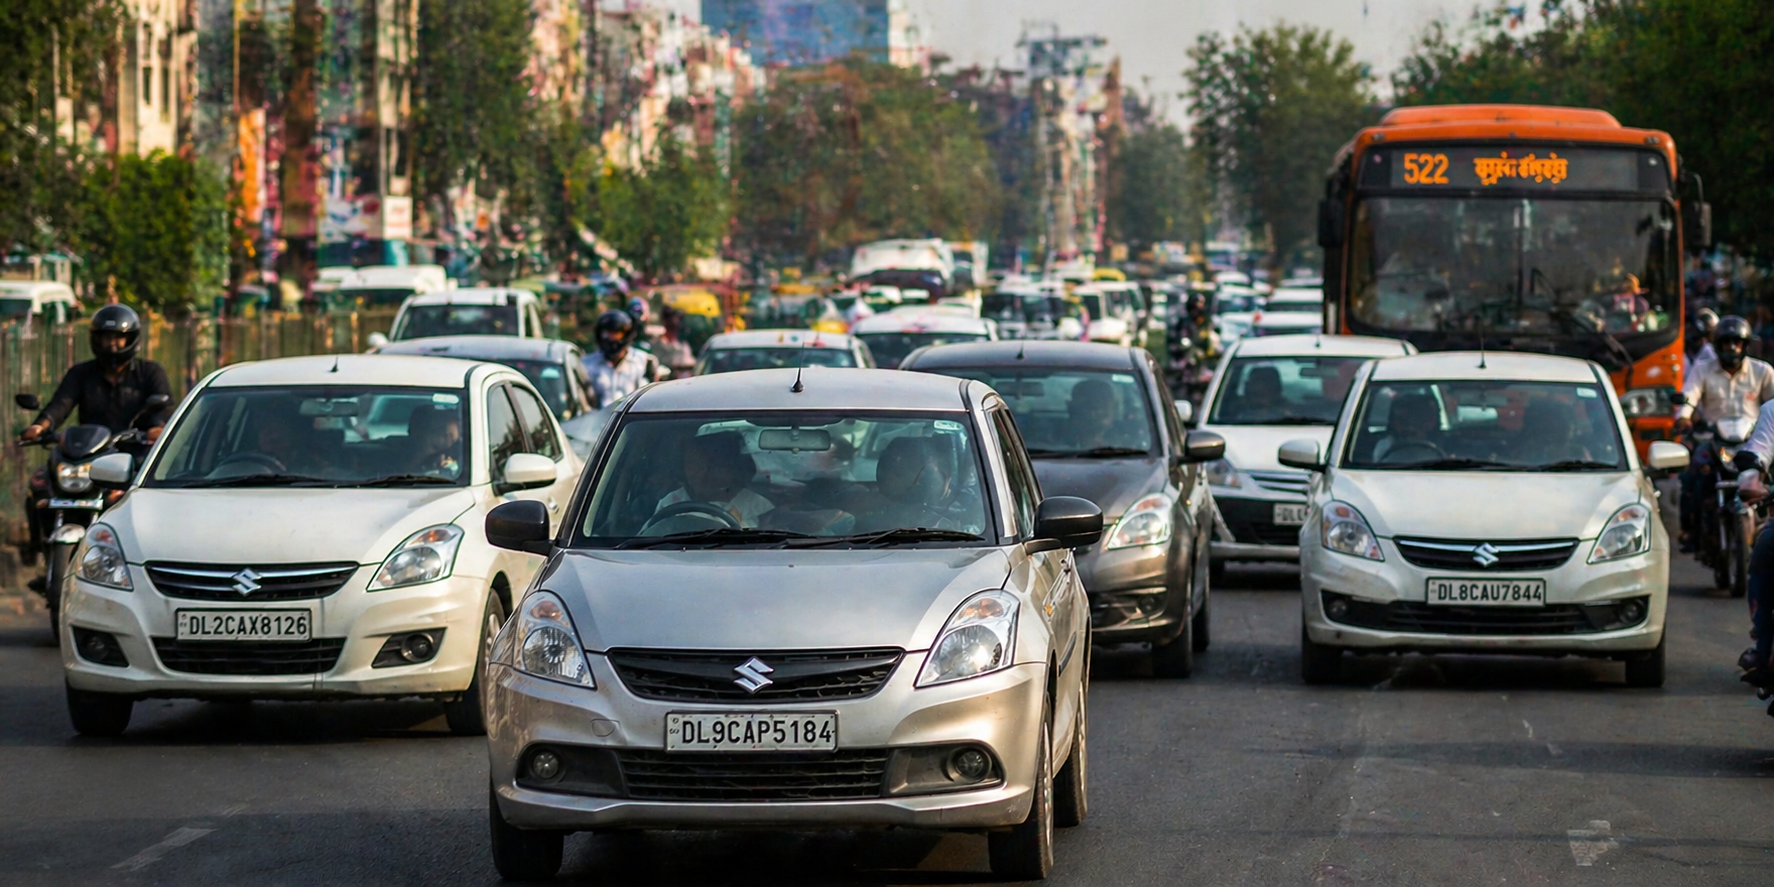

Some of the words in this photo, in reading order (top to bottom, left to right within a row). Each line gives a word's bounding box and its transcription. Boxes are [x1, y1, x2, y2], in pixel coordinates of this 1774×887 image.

[1404, 153, 1449, 184] 522
[1438, 583, 1542, 601] DL8CAU7844
[189, 616, 307, 635] DL2CAX8126
[682, 720, 833, 744] DL9CAP5184
